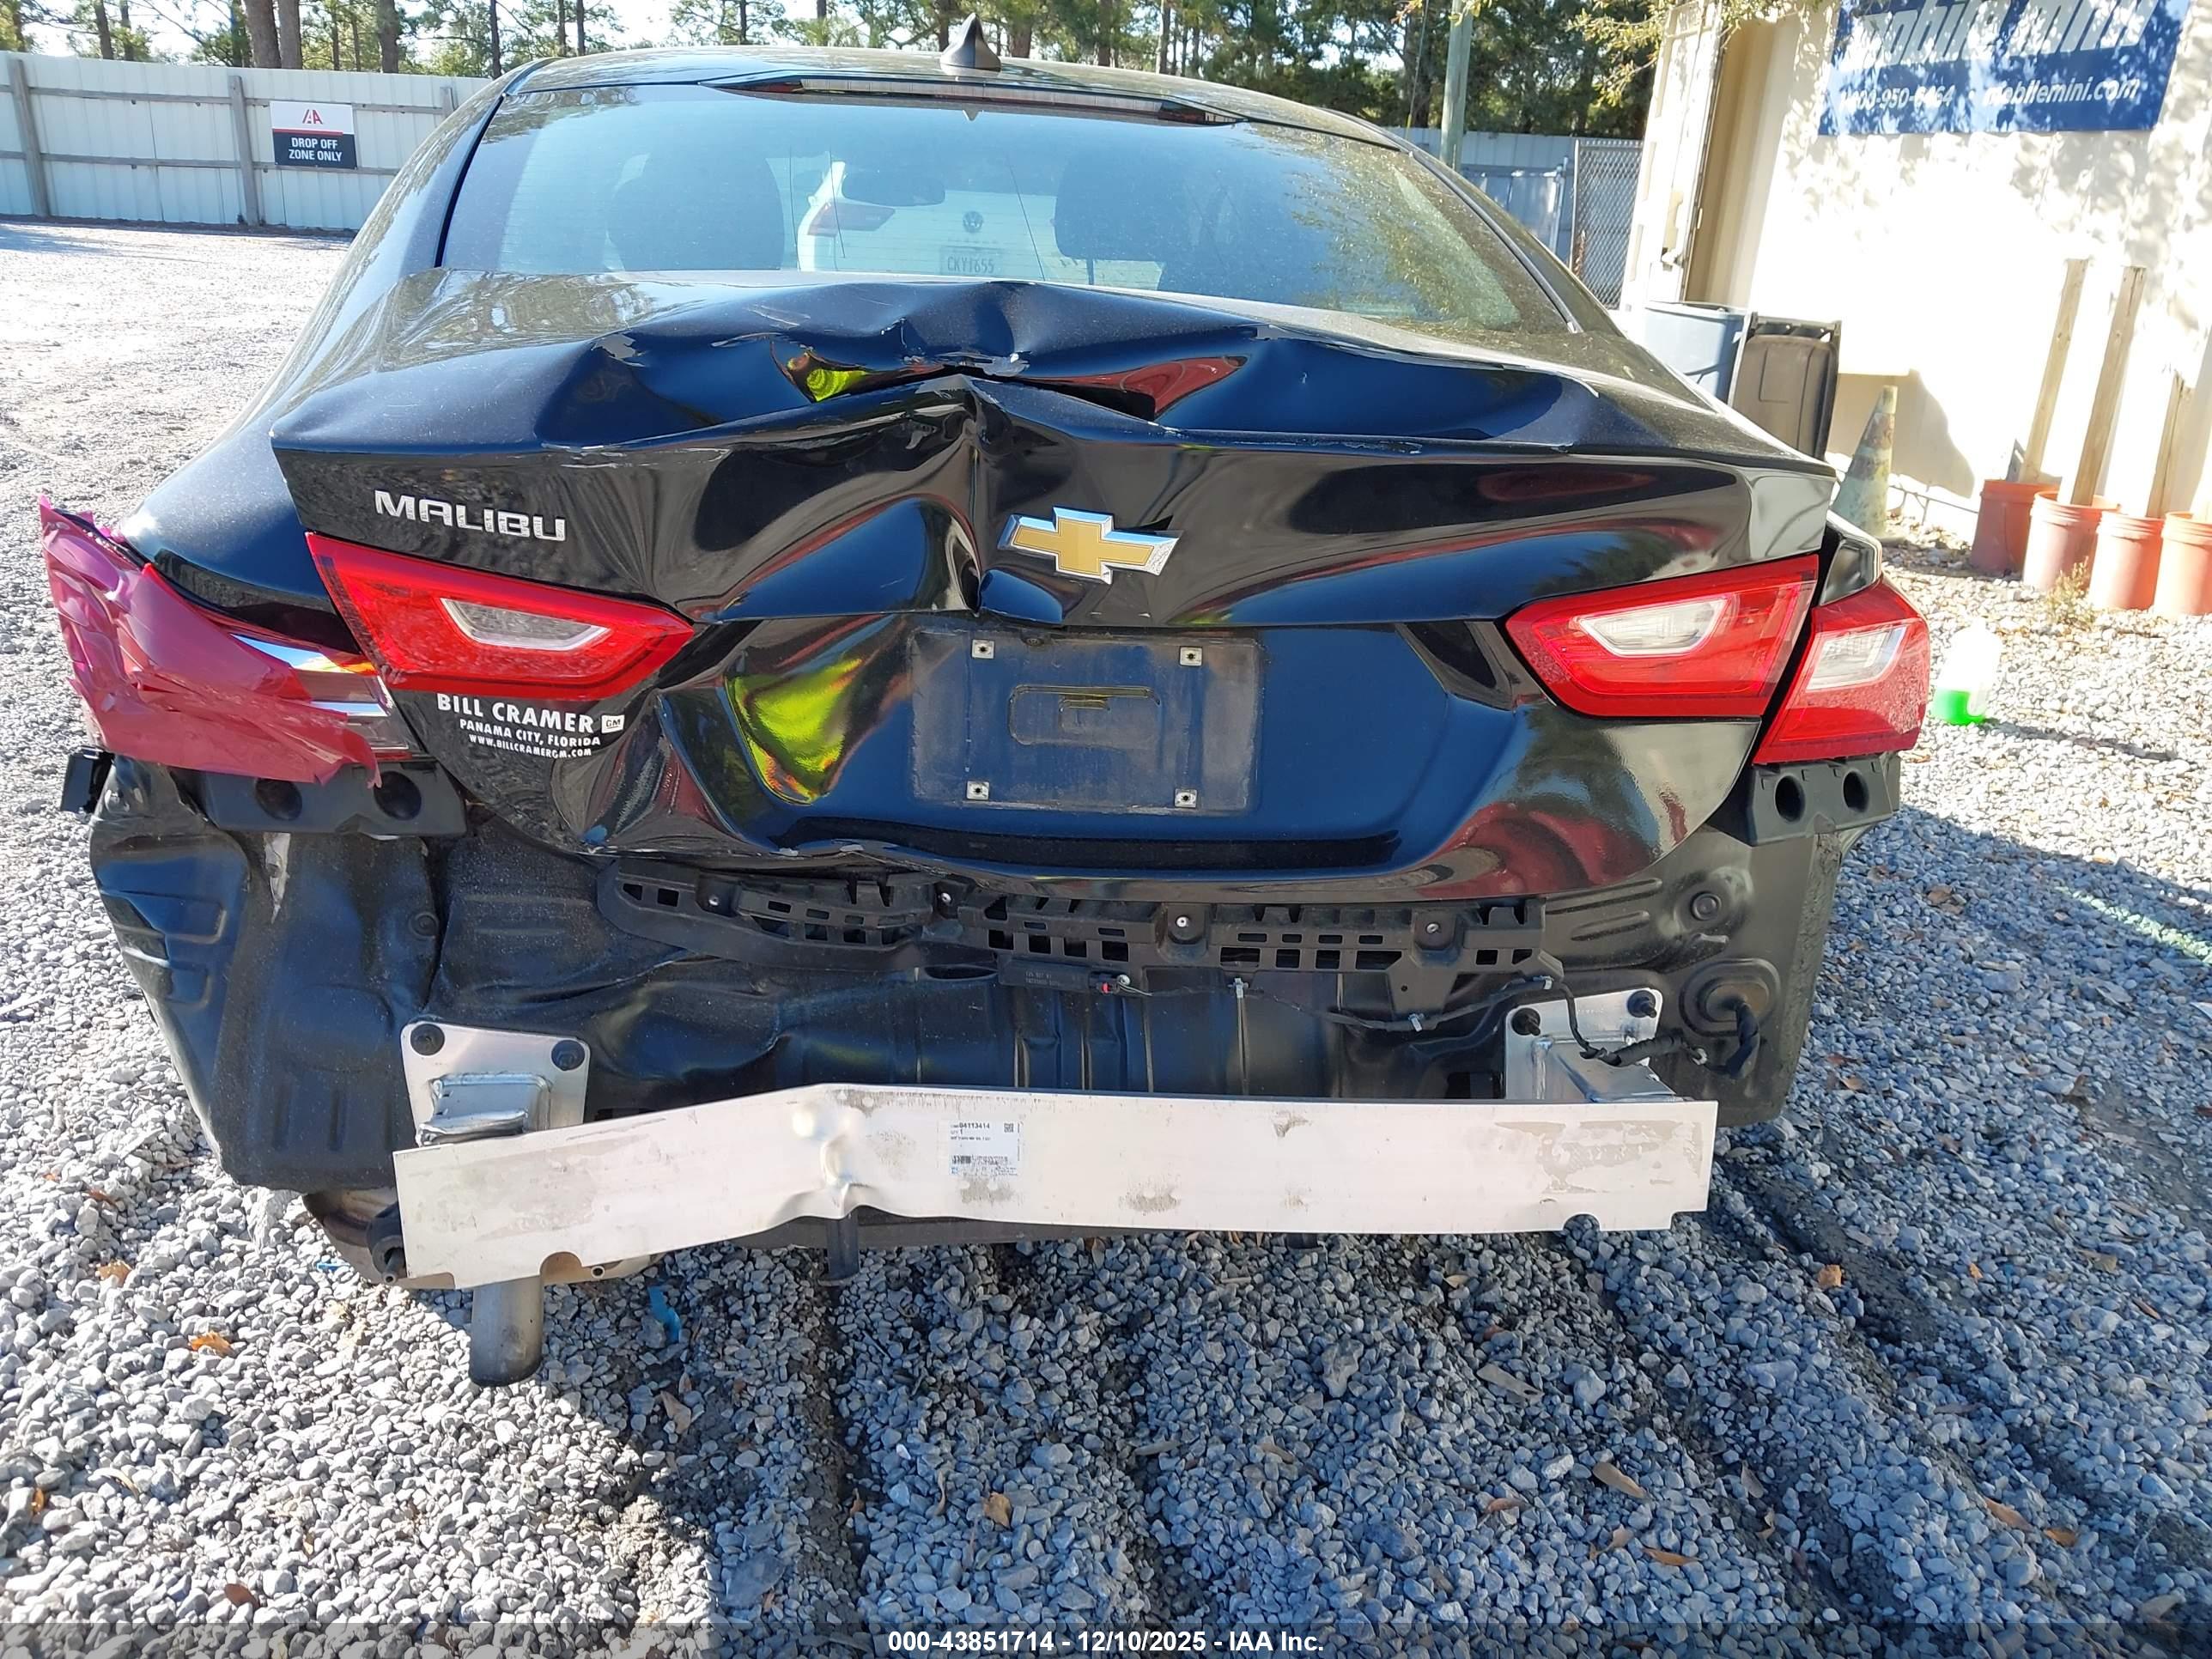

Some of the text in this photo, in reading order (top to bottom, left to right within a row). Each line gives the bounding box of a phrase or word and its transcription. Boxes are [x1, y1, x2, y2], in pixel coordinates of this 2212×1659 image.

[1983, 76, 2141, 106] mobilemini.com
[289, 149, 343, 161] ZONE ONLY
[291, 137, 338, 149] DROP OFF
[374, 489, 566, 542] MALIBU
[436, 693, 484, 718] BILL
[492, 702, 594, 734] CRAMER
[459, 718, 601, 748] PANAMA CITY, FLORIDA
[468, 734, 592, 759] WWW.BILLCRAMERGM.COM
